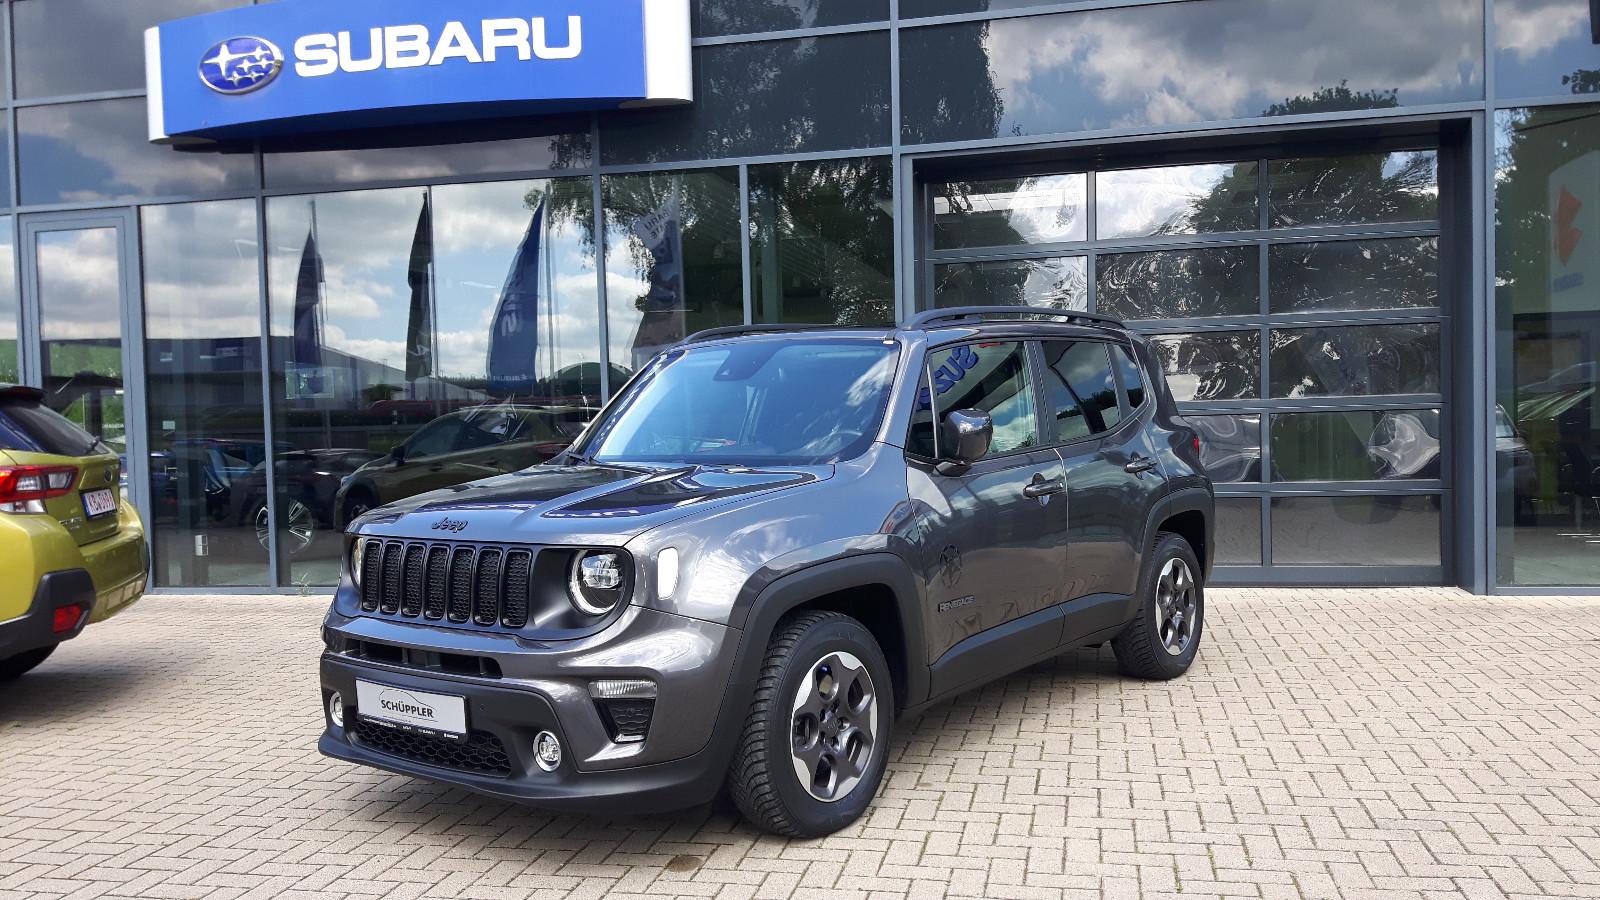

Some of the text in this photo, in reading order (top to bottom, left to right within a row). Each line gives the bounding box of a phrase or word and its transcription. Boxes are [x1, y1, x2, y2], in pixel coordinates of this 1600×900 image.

[293, 15, 582, 78] SUBARU
[431, 516, 468, 533] Jeep
[380, 699, 434, 718] SCHÜPPLER
